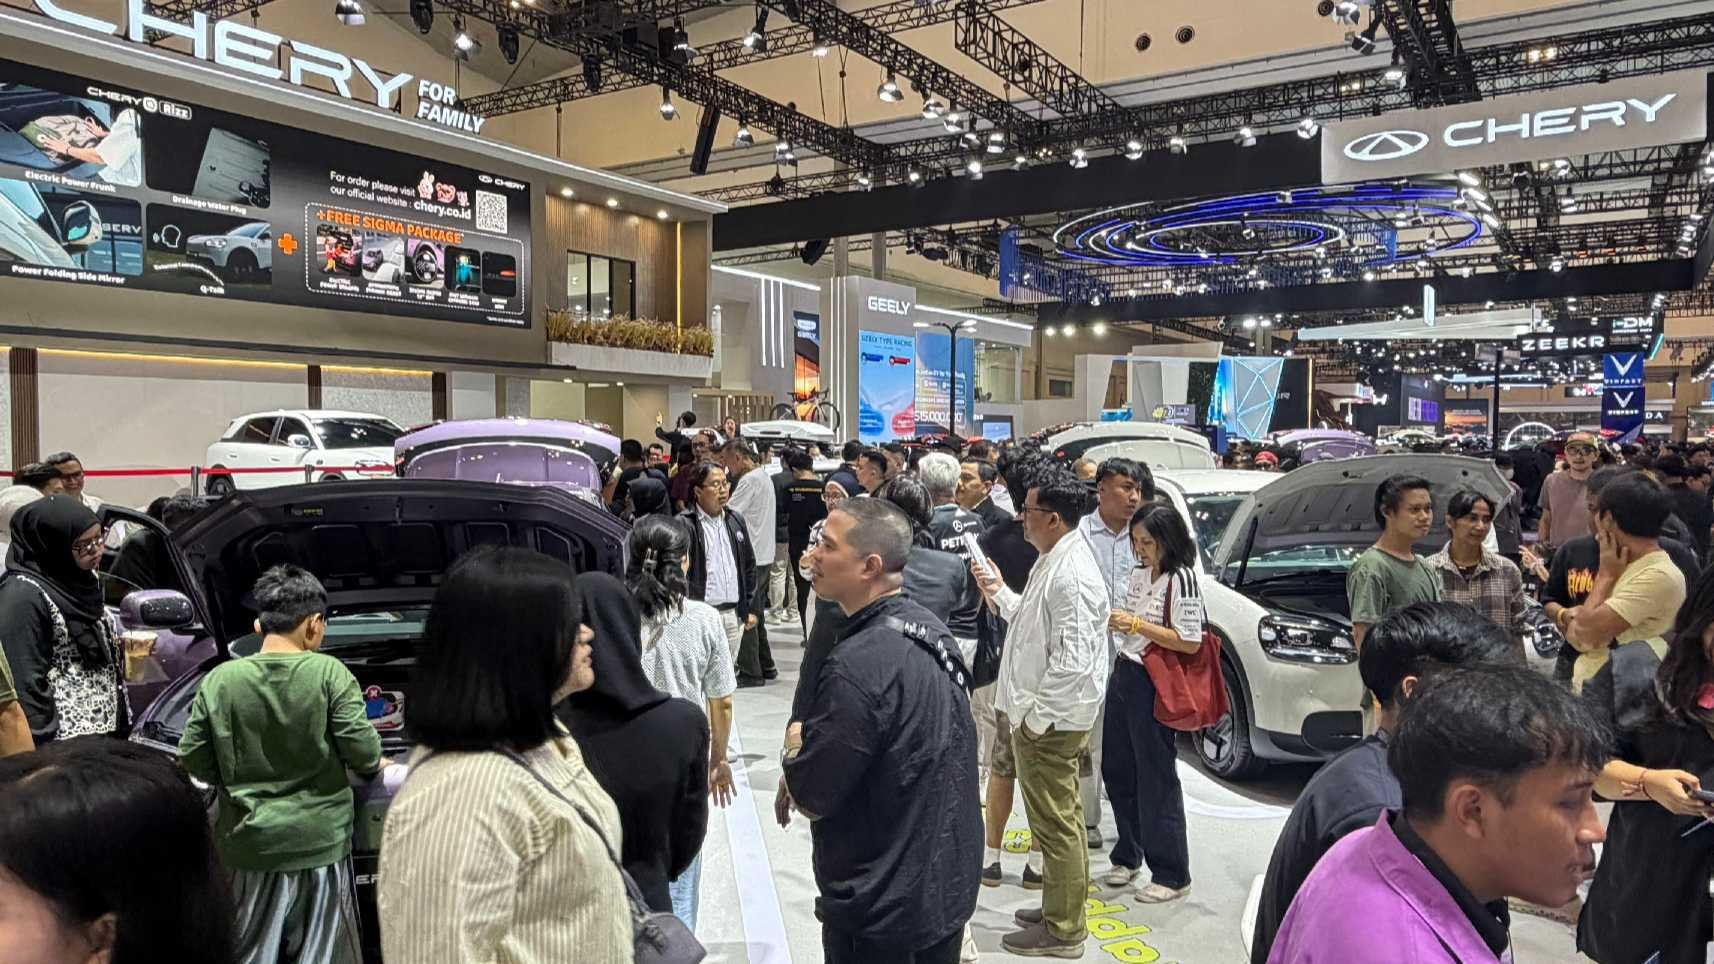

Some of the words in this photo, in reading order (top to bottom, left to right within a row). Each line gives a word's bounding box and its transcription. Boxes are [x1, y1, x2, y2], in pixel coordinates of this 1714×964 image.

[86, 86, 141, 106] CHERY
[418, 79, 456, 105] FOR
[418, 103, 485, 133] FAMILY
[1443, 93, 1678, 148] CHERY
[25, 170, 60, 183] Electric
[61, 176, 89, 188] Power
[330, 170, 345, 183] For
[347, 174, 370, 188] order
[371, 178, 398, 195] please
[399, 184, 415, 198] visit
[494, 178, 525, 190] CHERY
[330, 185, 345, 196] our
[347, 187, 375, 202] official
[376, 193, 408, 208] website
[413, 200, 471, 220] chery.co.id
[362, 215, 404, 233] SIGMA
[12, 265, 41, 276] Power
[43, 267, 77, 280] Folding
[78, 270, 97, 281] Side
[98, 273, 125, 284] Mirror
[867, 295, 911, 316] GEELY
[1522, 336, 1604, 351] ZEEKR
